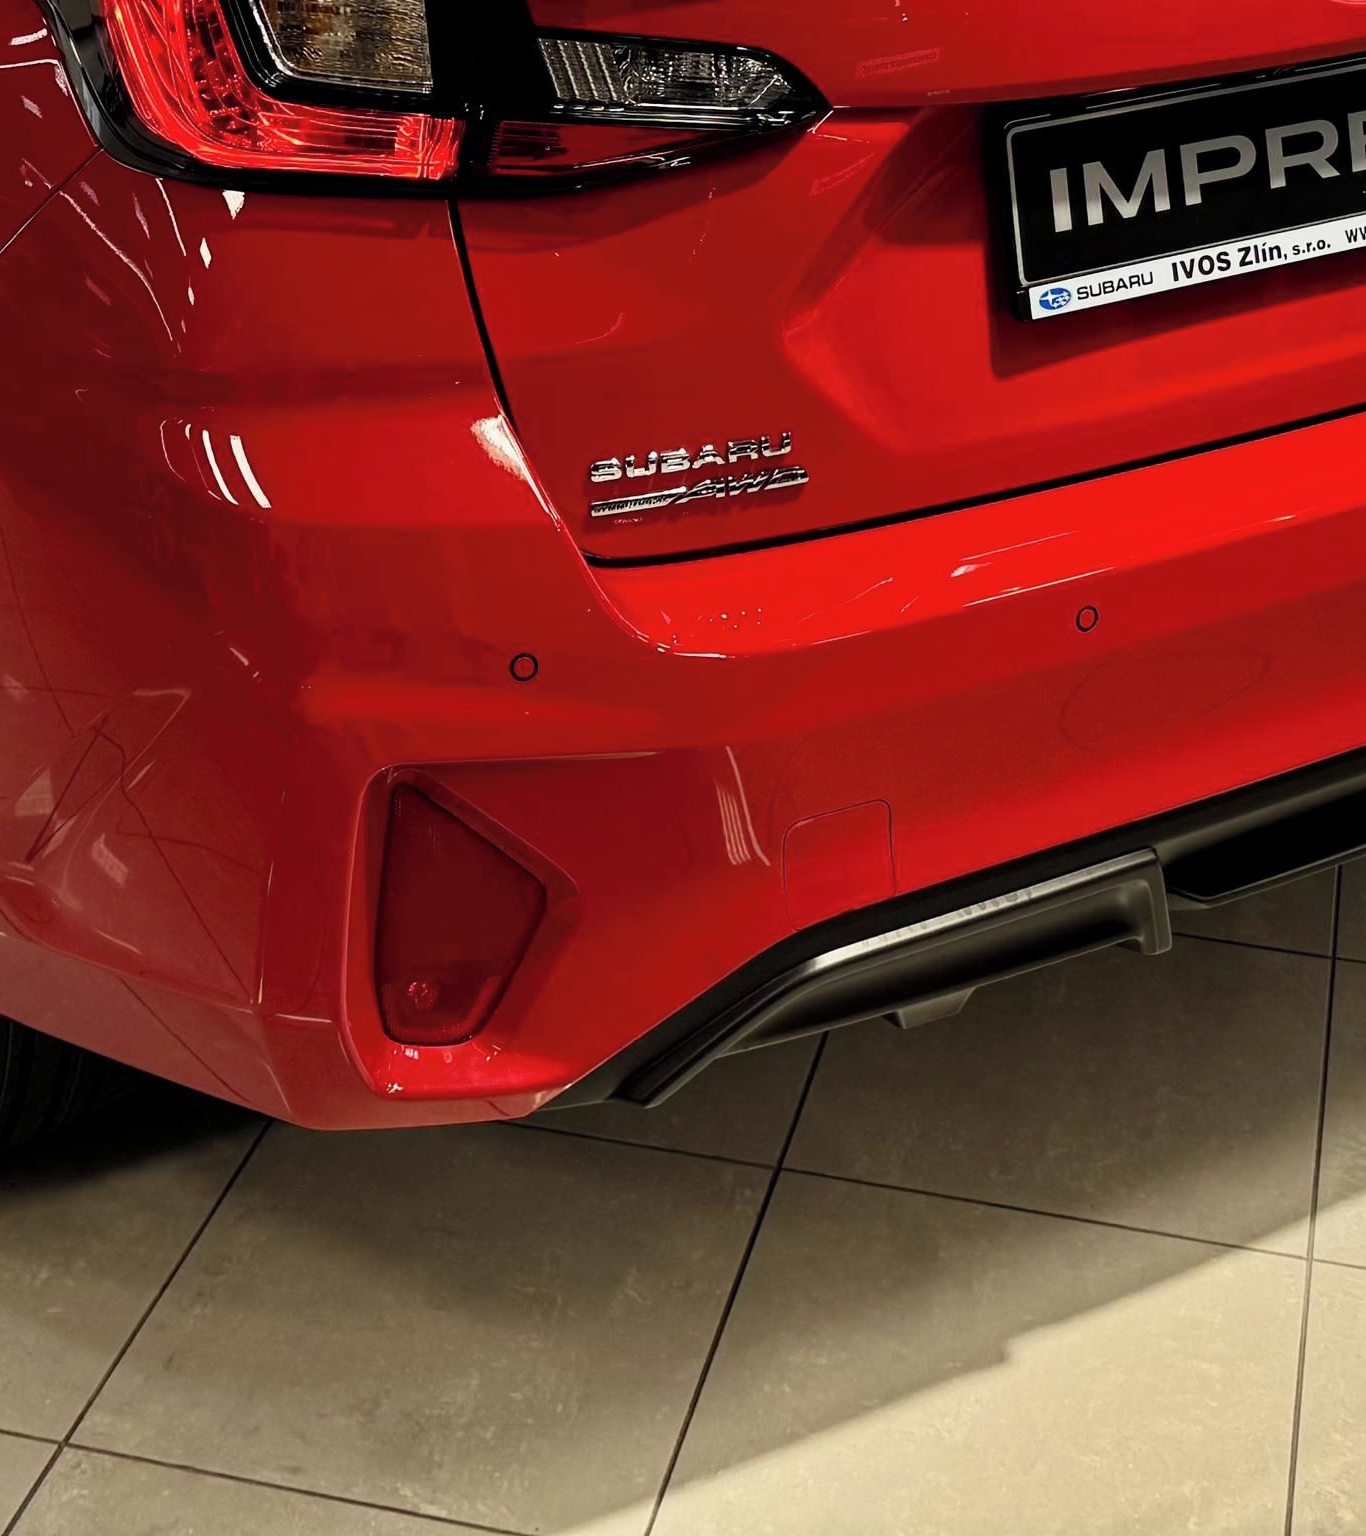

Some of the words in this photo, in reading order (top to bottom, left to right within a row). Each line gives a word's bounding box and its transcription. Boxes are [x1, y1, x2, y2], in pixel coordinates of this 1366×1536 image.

[1076, 271, 1154, 301] SUBARU
[1171, 251, 1231, 282] IVOS
[1237, 241, 1289, 268] Zlín,
[1291, 238, 1332, 256] s.r.o.
[590, 431, 792, 483] SUBARU
[675, 465, 810, 505] AWD
